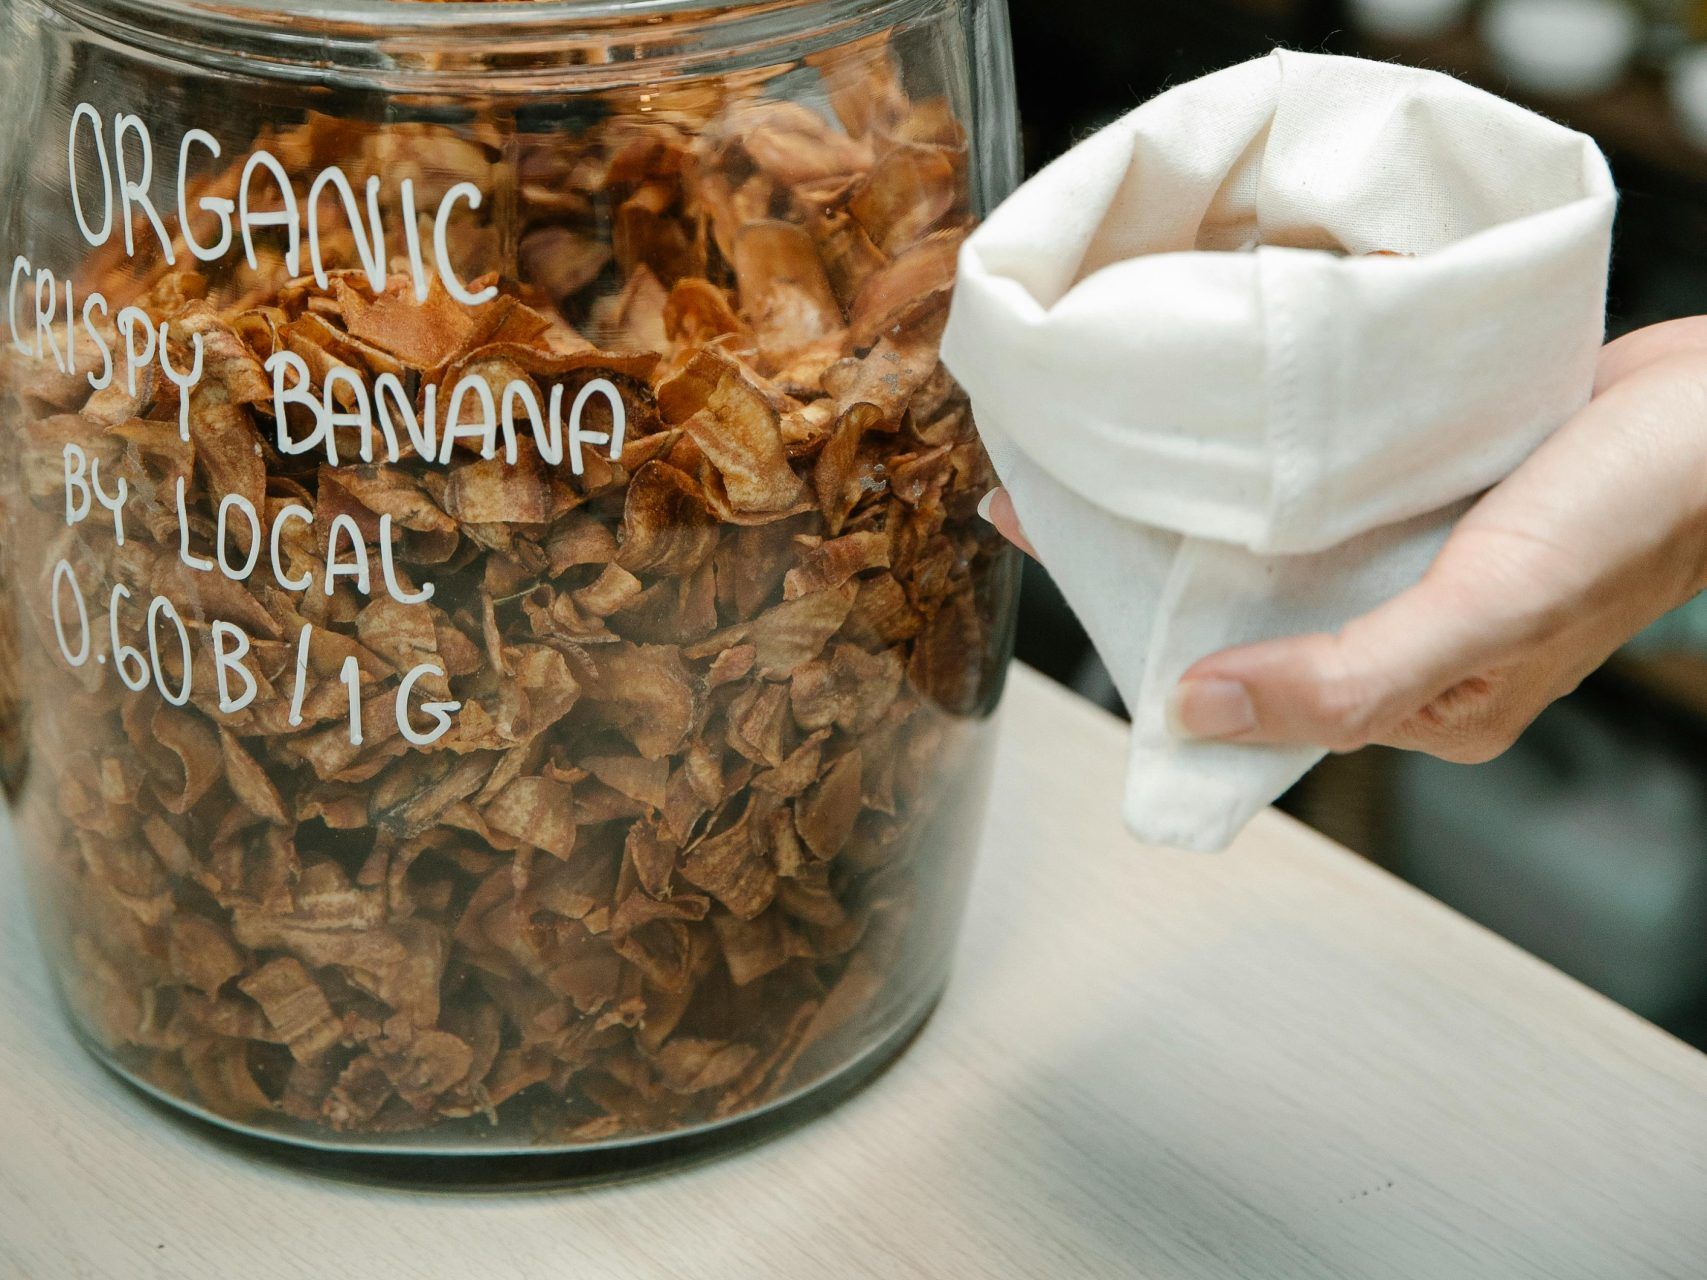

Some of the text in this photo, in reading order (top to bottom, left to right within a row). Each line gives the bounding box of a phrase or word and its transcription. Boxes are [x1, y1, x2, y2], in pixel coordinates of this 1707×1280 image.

[69, 103, 498, 305] ORGANIC
[8, 255, 625, 475] CRISPY BANANA
[64, 444, 434, 603] BY LOCAL
